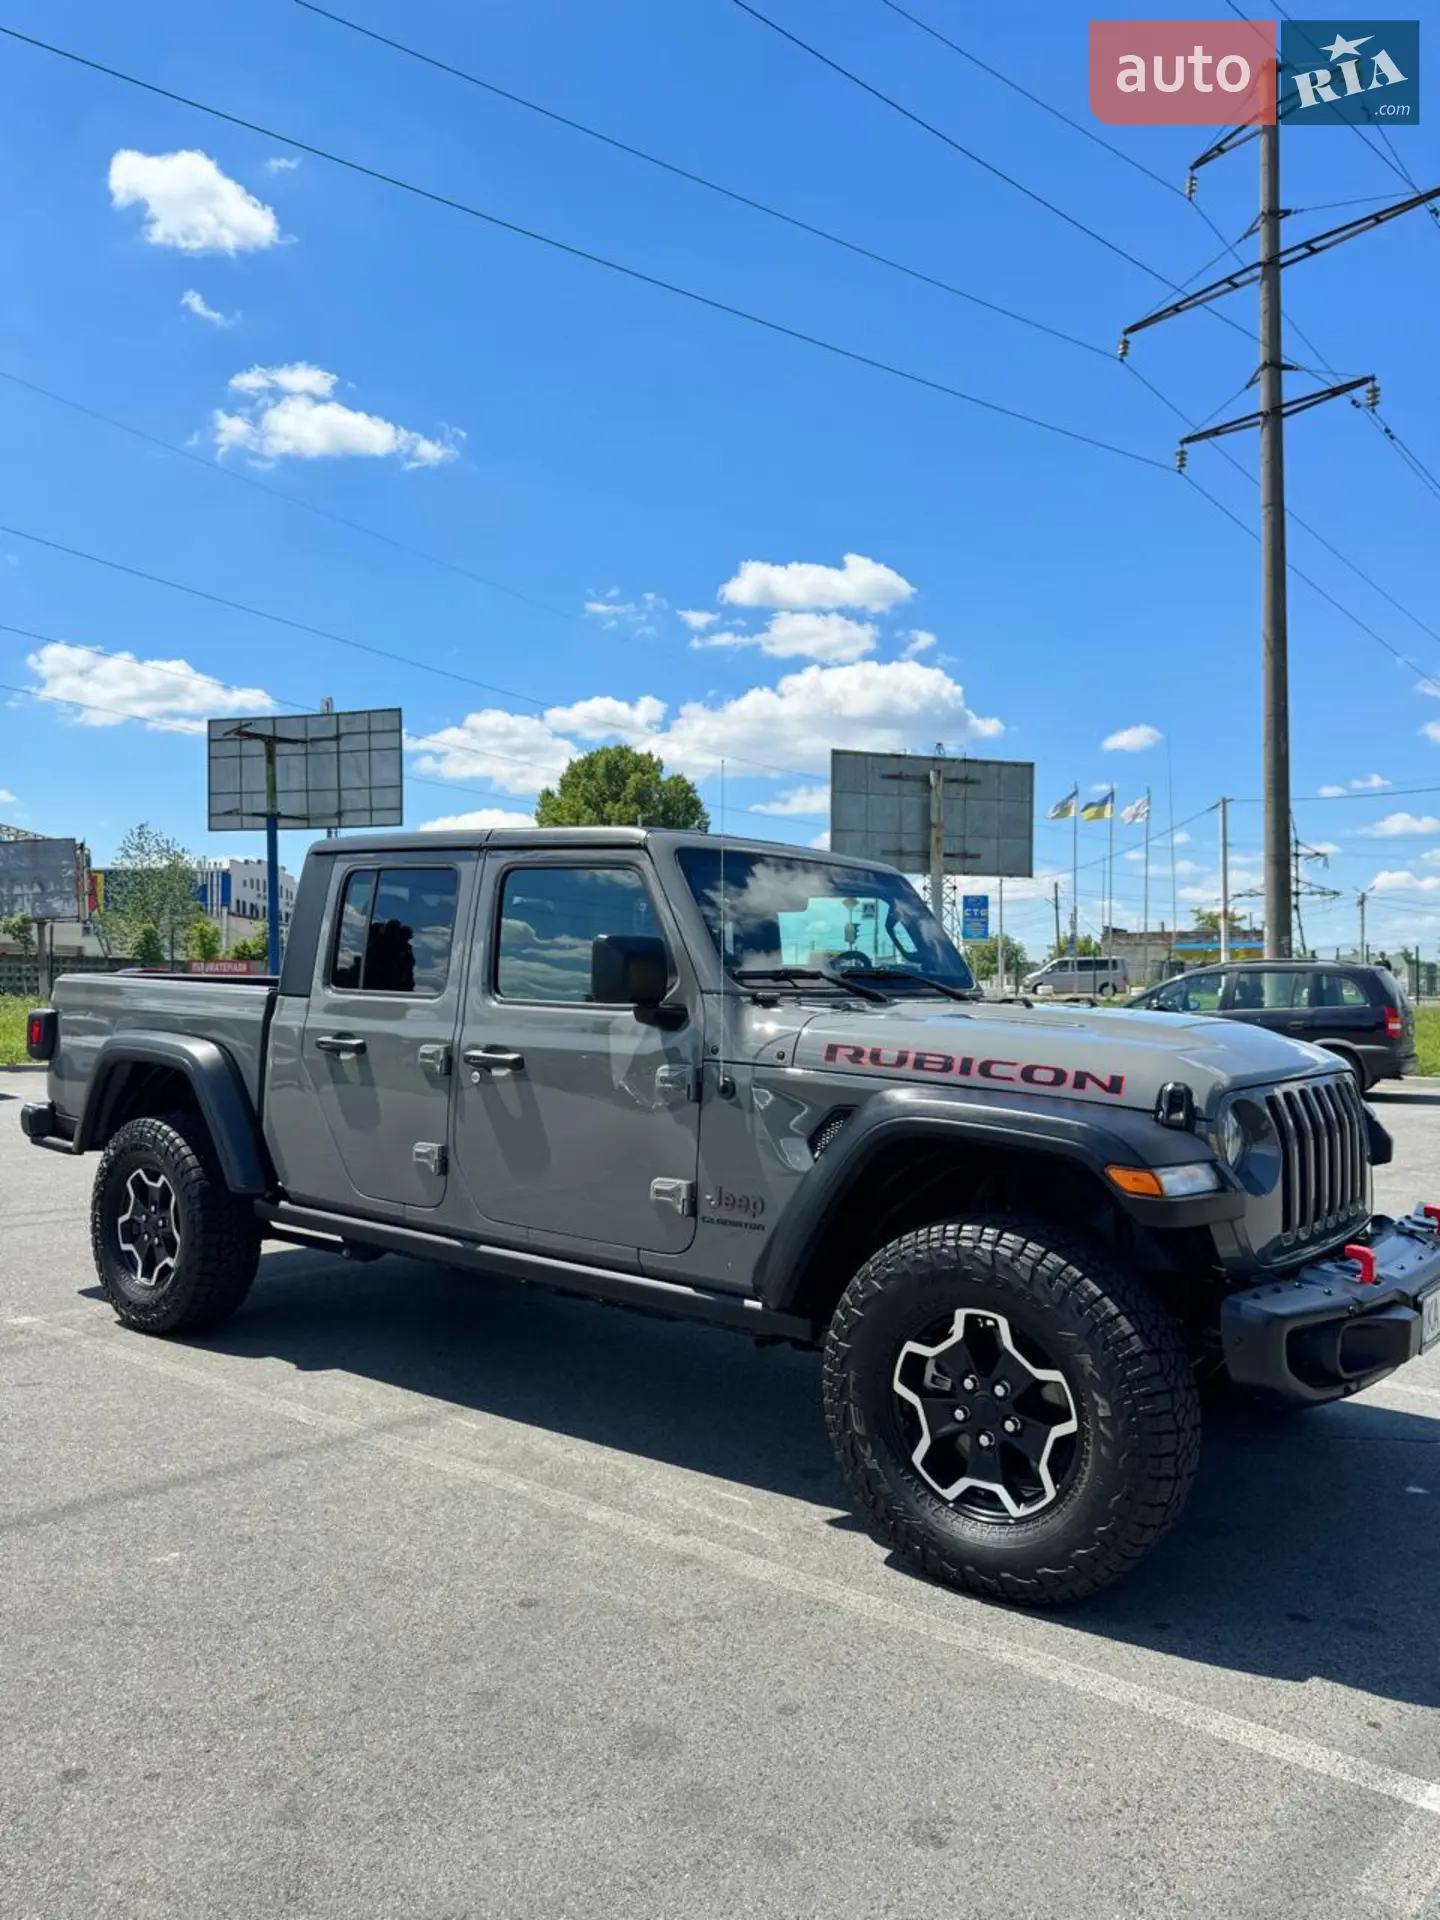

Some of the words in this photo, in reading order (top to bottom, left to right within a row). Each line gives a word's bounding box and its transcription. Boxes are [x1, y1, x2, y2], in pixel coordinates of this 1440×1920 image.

[824, 1042, 1126, 1097] RUBICON
[705, 1186, 765, 1218] Jeep
[701, 1216, 766, 1231] GLADIATOR
